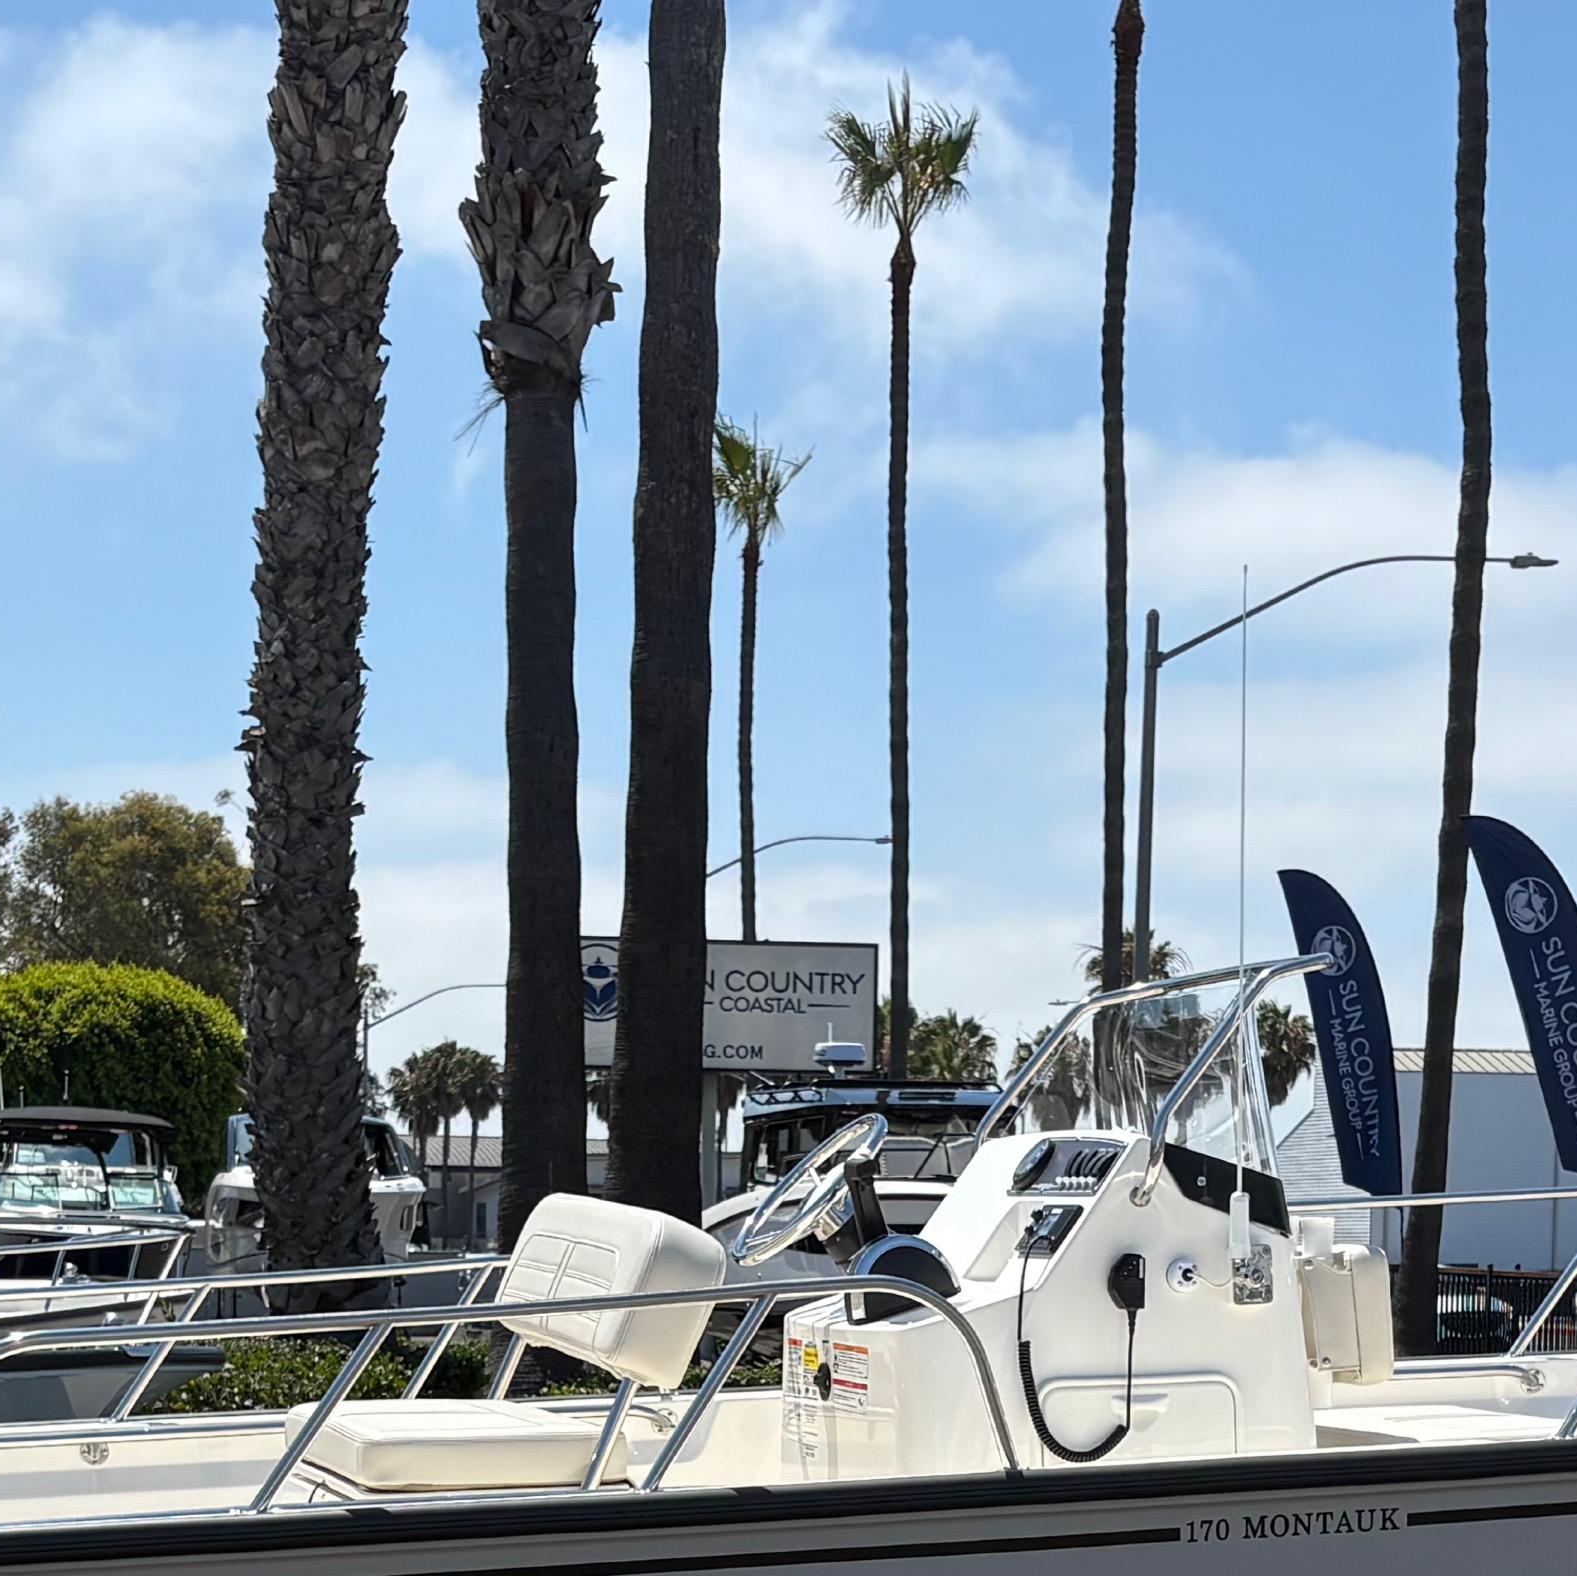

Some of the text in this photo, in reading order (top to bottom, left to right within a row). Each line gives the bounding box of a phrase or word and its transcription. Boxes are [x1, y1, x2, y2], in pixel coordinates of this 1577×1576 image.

[725, 969, 866, 995] COUNTRY
[1542, 936, 1576, 997] SUN
[719, 996, 807, 1014] COASTAL
[1533, 981, 1564, 1047] MARINE
[703, 1044, 763, 1060] G.COM
[1329, 1019, 1363, 1131] MARINE GROUP
[1339, 979, 1381, 1158] SUN COUNTRY
[1186, 1507, 1400, 1543] 170 MONTAUK
